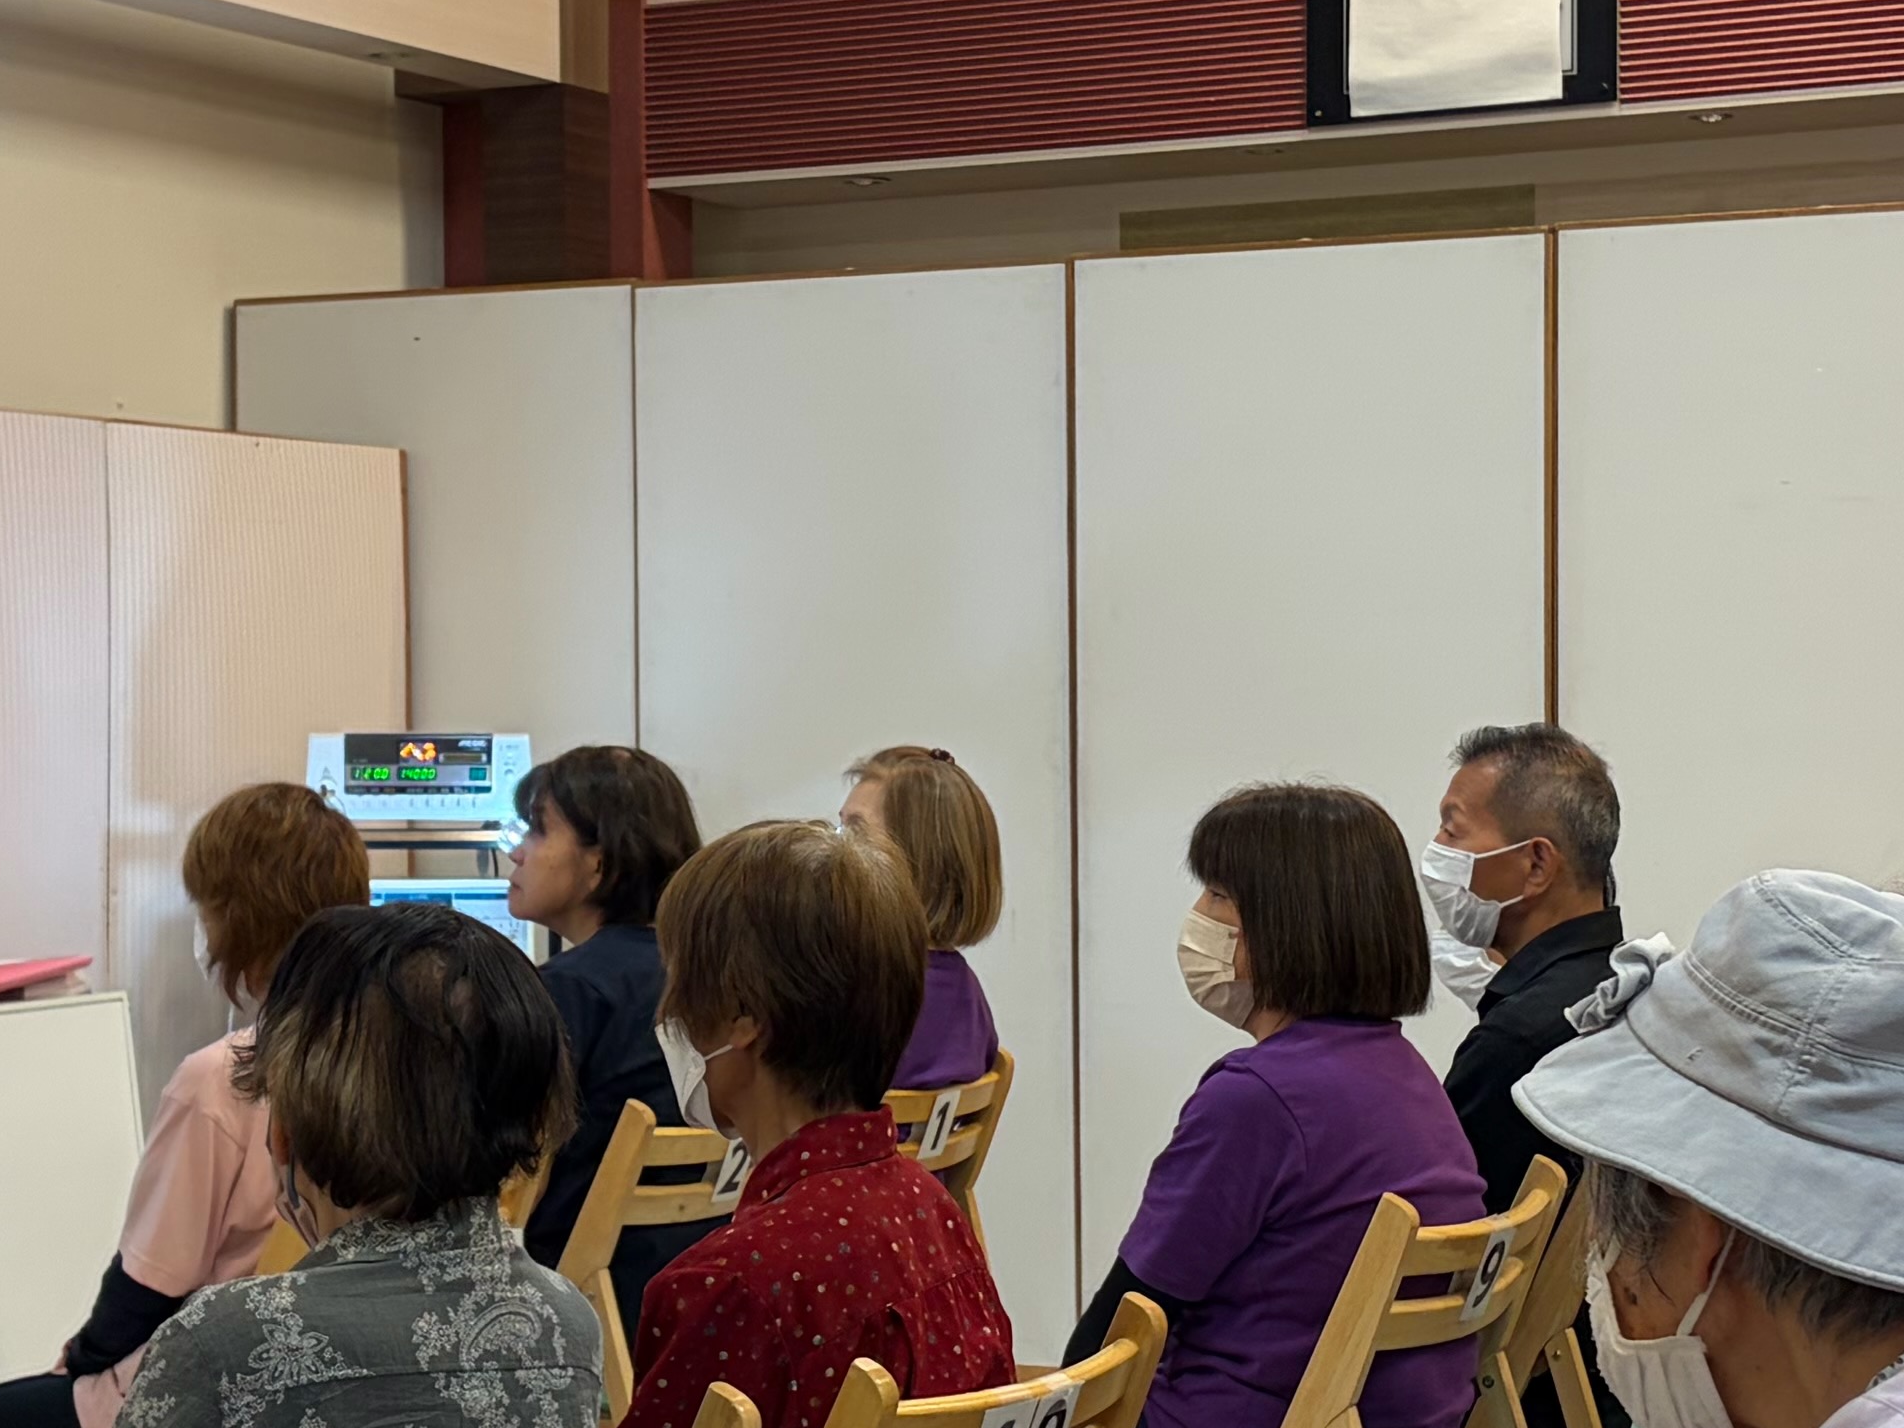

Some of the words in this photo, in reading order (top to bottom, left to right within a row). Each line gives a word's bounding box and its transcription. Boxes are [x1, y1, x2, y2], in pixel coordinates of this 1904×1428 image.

[930, 1102, 950, 1150] 1
[717, 1144, 747, 1195] 2
[1472, 1240, 1505, 1307] 9
